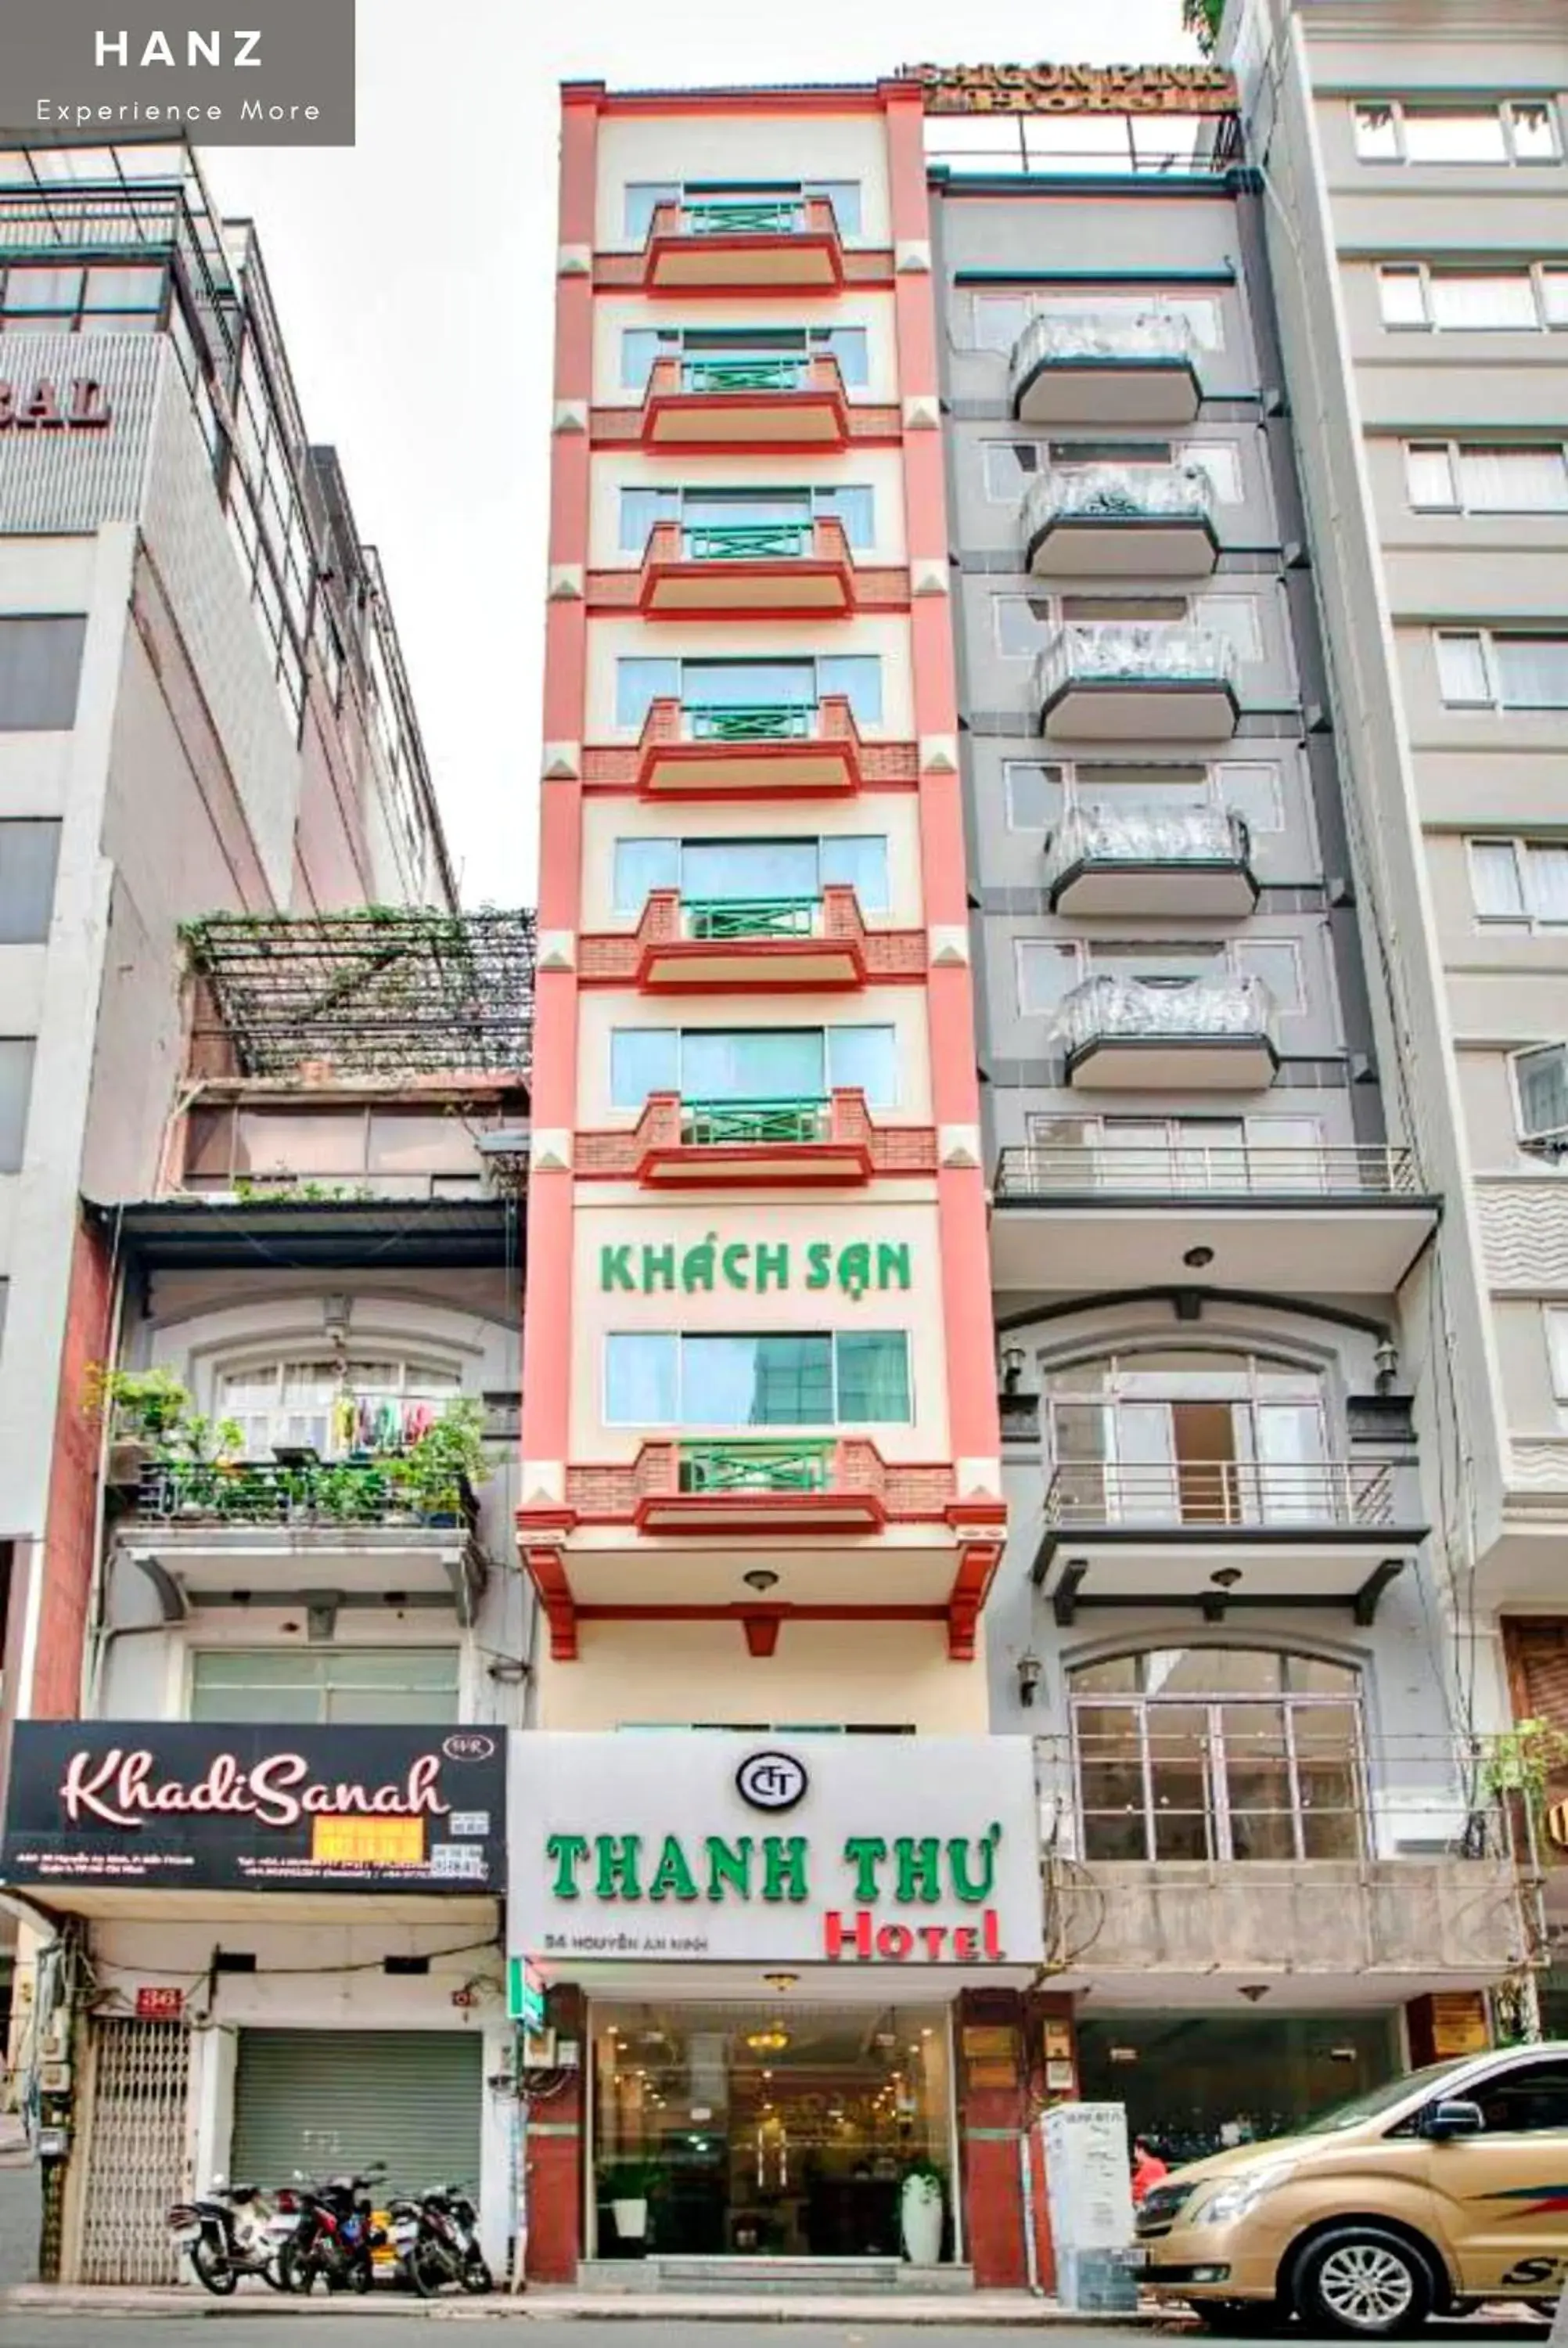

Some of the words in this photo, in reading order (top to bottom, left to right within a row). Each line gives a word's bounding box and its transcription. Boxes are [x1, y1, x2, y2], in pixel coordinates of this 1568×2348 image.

[600, 1231, 789, 1294] KHÁCH
[805, 1241, 912, 1302] SẠN
[547, 1834, 810, 1903] THANH
[844, 1821, 1003, 1903] THƯ
